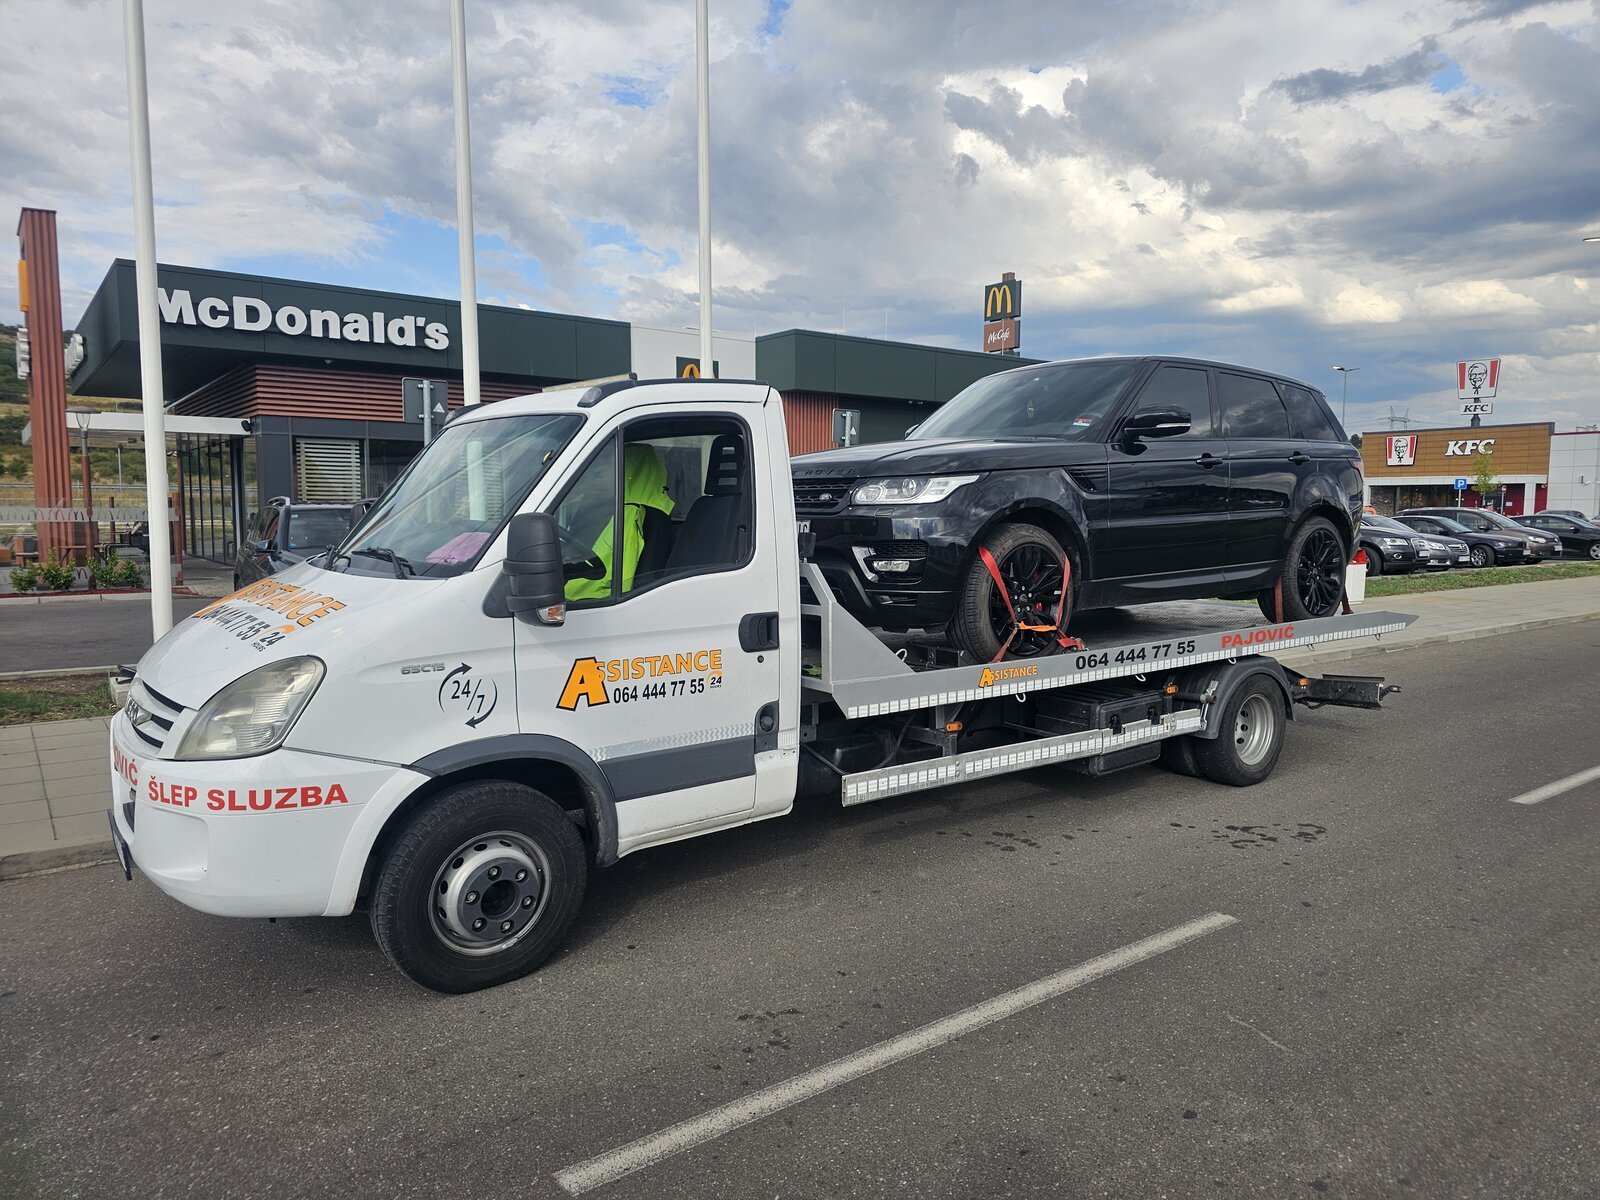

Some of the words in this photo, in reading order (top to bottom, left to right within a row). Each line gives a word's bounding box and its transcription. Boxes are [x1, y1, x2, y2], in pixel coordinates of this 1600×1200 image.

[157, 287, 450, 350] McDonald's
[1463, 404, 1489, 413] KFC
[1444, 439, 1496, 456] KFC
[225, 614, 259, 632] 77
[235, 621, 271, 641] 55
[259, 631, 286, 647] 24
[1221, 623, 1295, 648] PAJOVIĆ
[1075, 652, 1110, 670] 064
[1114, 647, 1147, 664] 444
[1152, 643, 1172, 659] 77
[1177, 640, 1196, 655] 55
[400, 662, 446, 675] 65C15
[556, 649, 723, 711] ASSISTANCE
[978, 665, 1039, 688] ASSISTANCE
[613, 685, 638, 704] 064
[642, 682, 667, 700] 444
[670, 680, 686, 697] 77
[690, 678, 705, 695] 55
[710, 676, 723, 685] 24
[451, 678, 486, 714] 24/7
[148, 776, 198, 807] ŠLEP
[206, 783, 349, 811] SLUZBA
